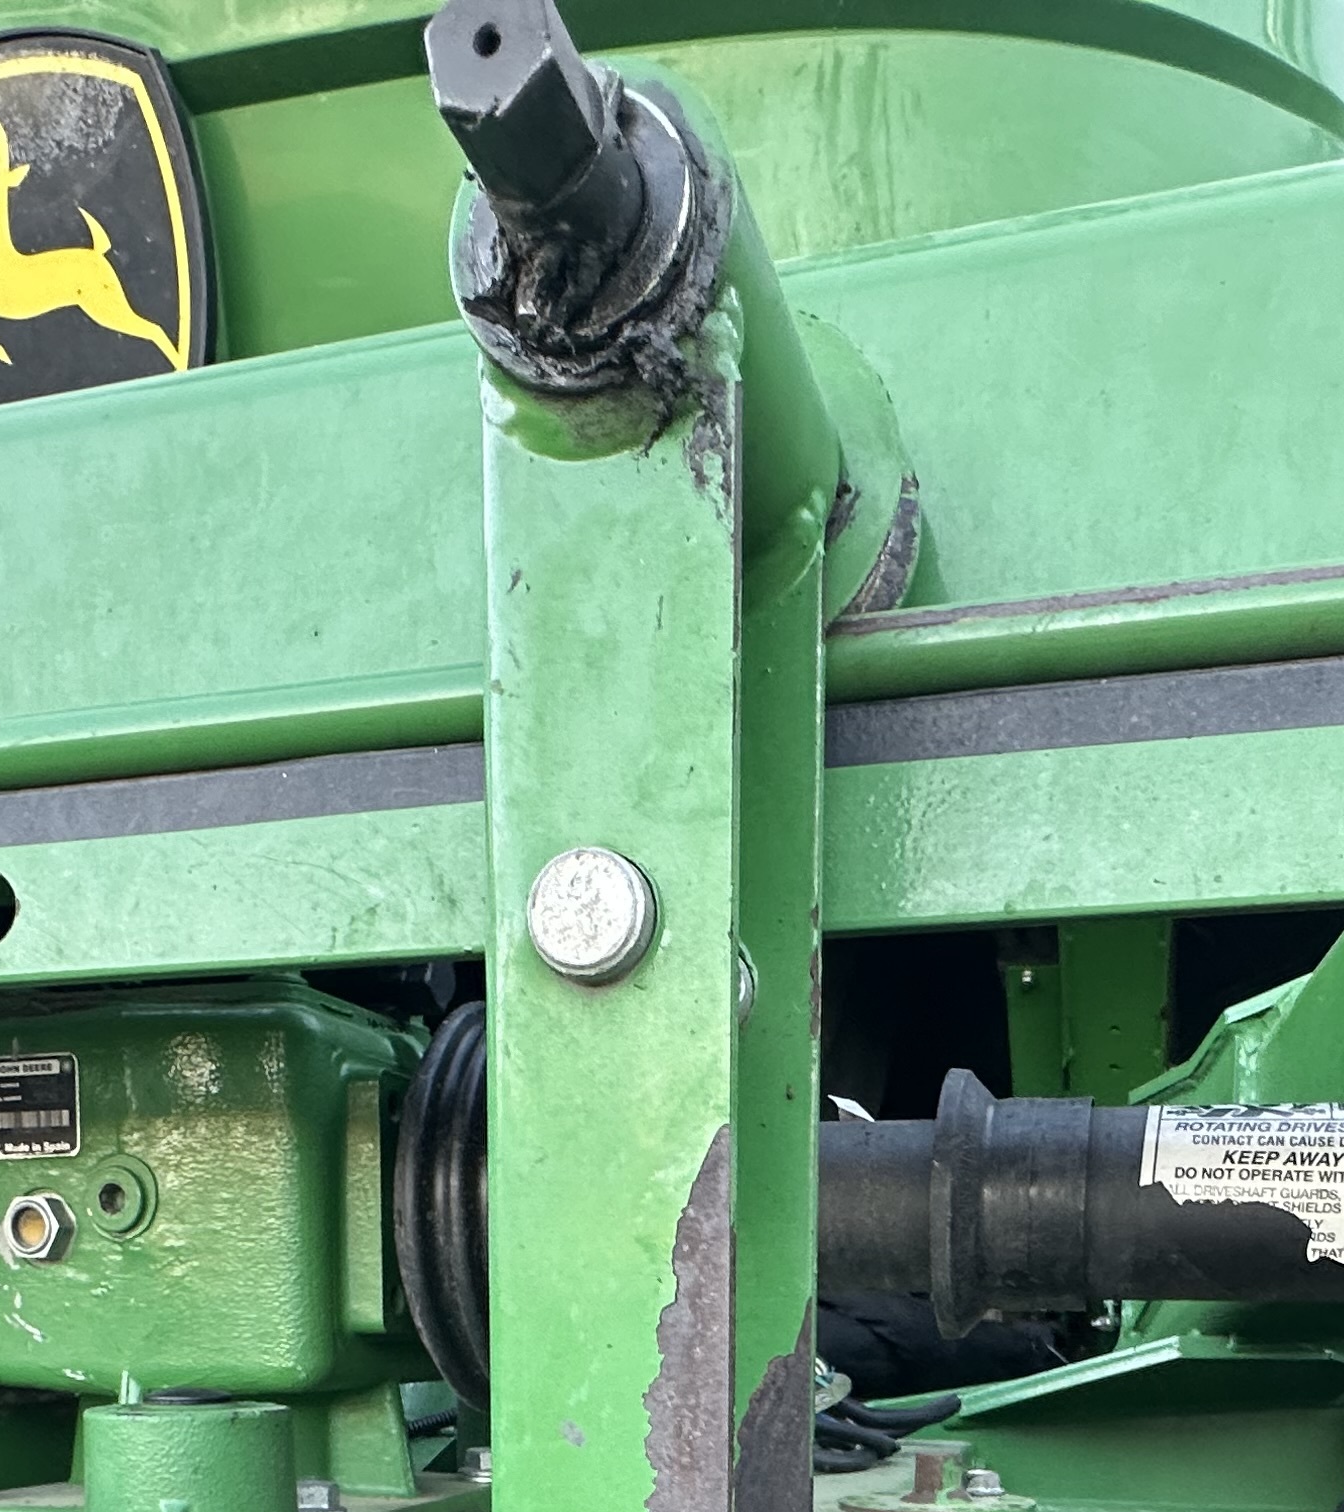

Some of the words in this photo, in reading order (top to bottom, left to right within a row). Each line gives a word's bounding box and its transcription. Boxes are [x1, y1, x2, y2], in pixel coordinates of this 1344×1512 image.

[22, 1063, 53, 1072] DEERE
[1174, 1121, 1271, 1132] ROTATING
[1192, 1134, 1253, 1146] CONTACT
[1257, 1135, 1285, 1147] CAN
[1289, 1136, 1335, 1148] CAUSE
[1222, 1150, 1280, 1166] KEEP
[1174, 1167, 1197, 1179] DO
[1202, 1168, 1235, 1180] NOT
[1239, 1168, 1314, 1182] OPERATE
[1194, 1184, 1277, 1198] DRIVESHAFT
[1280, 1187, 1341, 1201] GUARDS,
[1283, 1201, 1342, 1214] SHIELDS
[1311, 1247, 1344, 1258] THAT
